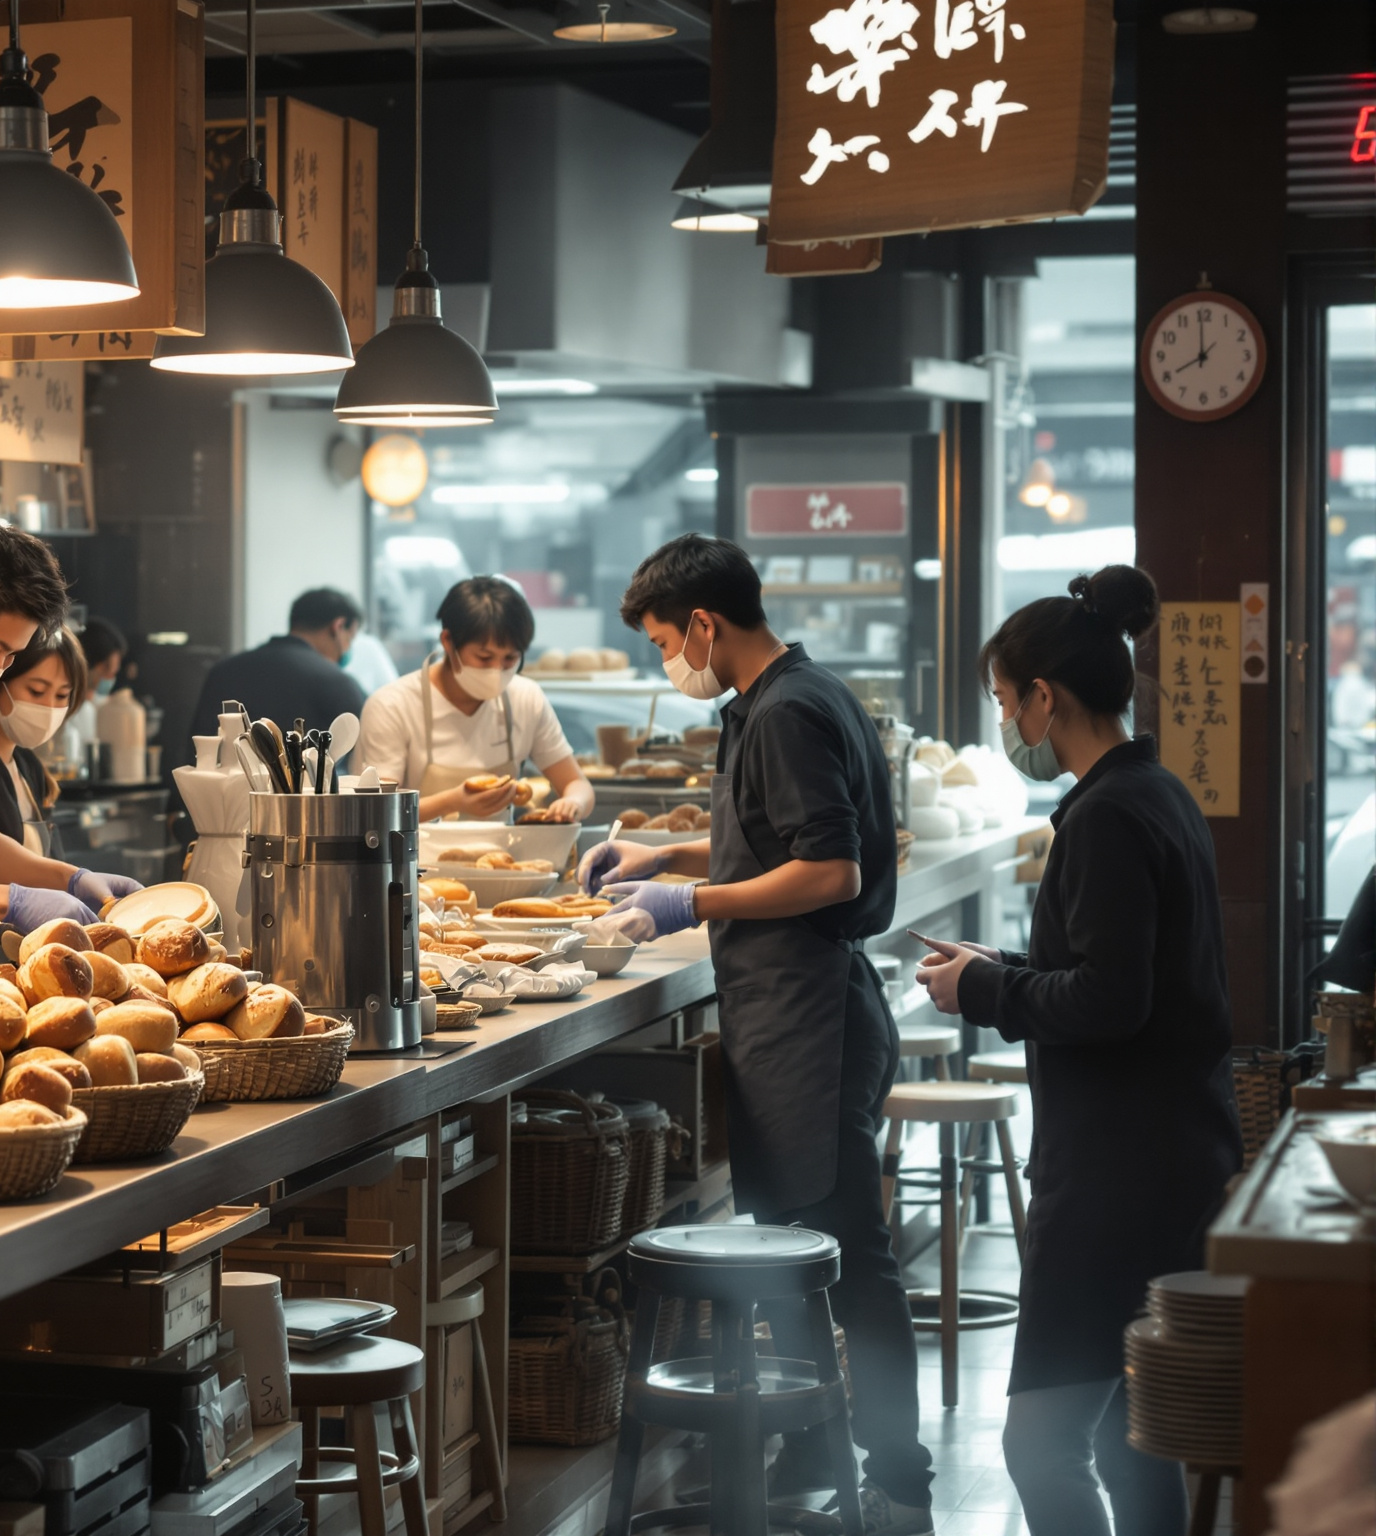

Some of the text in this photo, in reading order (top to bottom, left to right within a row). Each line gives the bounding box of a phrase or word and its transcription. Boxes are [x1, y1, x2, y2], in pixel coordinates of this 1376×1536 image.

[1177, 314, 1189, 328] 11
[1197, 308, 1212, 322] 12
[1162, 331, 1176, 345] 10
[1237, 329, 1246, 342] 2
[1156, 350, 1165, 363] 9
[1243, 349, 1252, 362] 3
[1162, 371, 1172, 383] 8
[1236, 370, 1245, 382] 4
[1178, 386, 1187, 398] 7
[1219, 385, 1229, 399] 5
